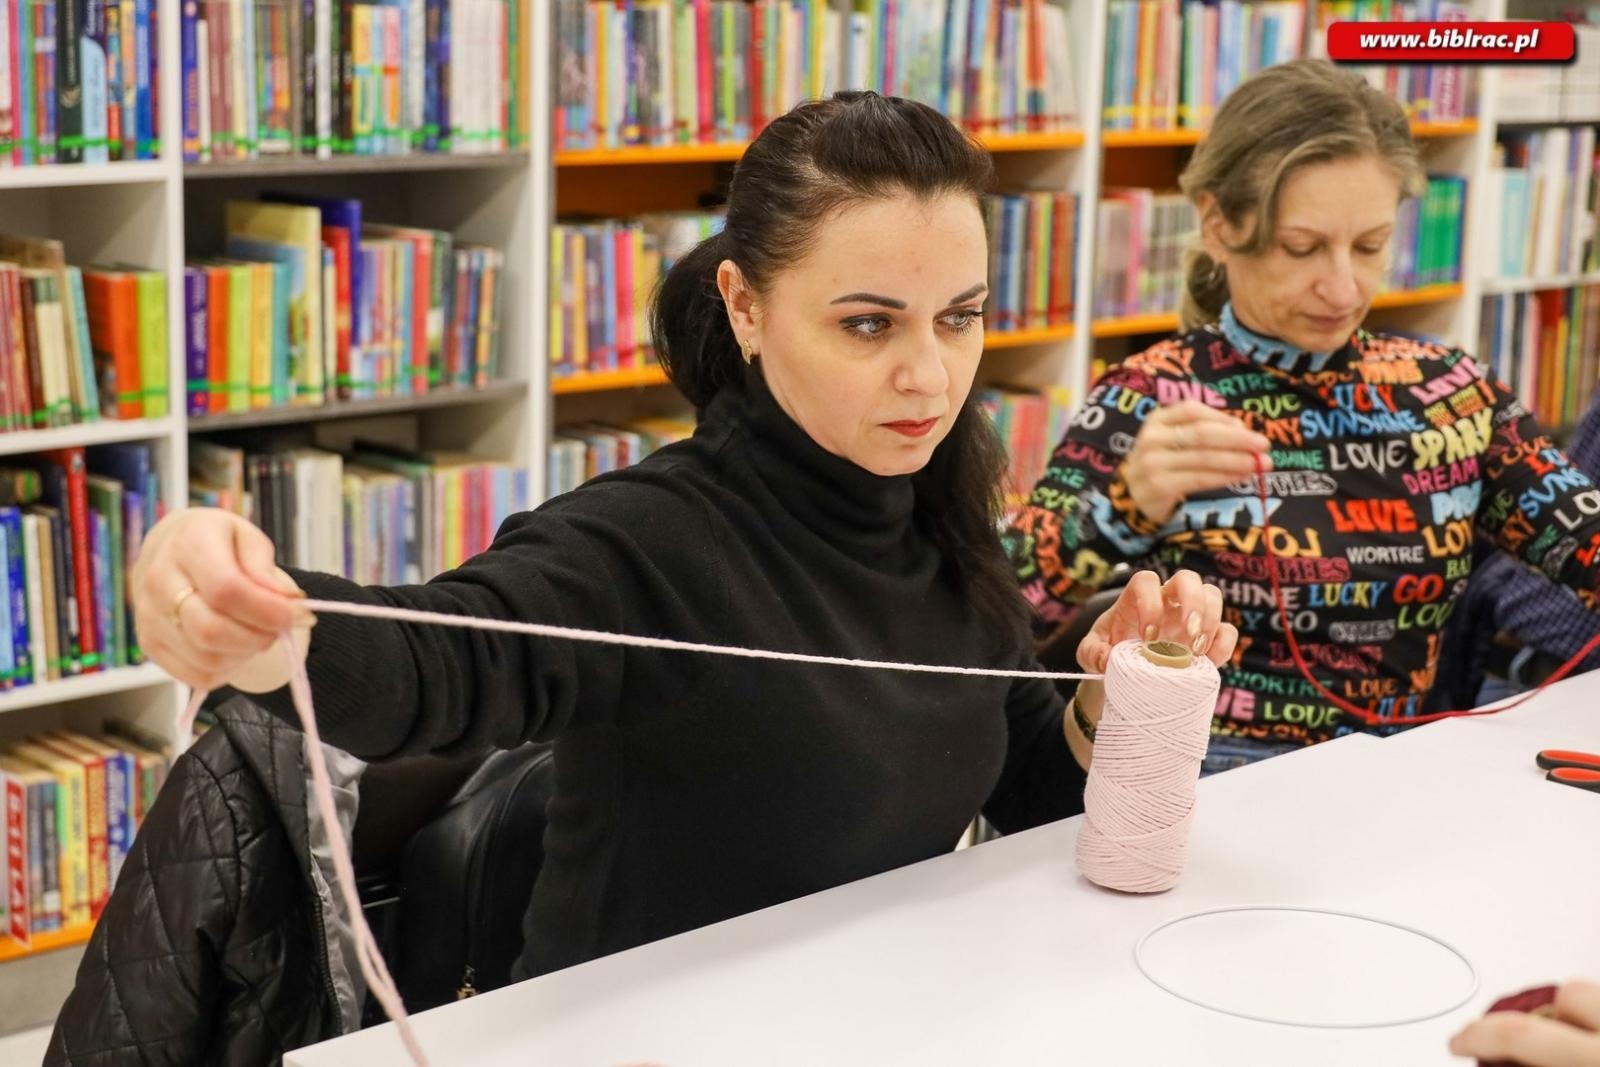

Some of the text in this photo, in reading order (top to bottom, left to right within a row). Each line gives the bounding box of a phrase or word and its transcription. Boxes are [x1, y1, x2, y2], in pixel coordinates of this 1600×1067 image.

[1327, 439, 1408, 478] LOVE
[1402, 456, 1480, 496] DREAM
[1325, 498, 1418, 534] LOVE
[1345, 544, 1425, 565] WORTRE
[1308, 580, 1388, 609] LUCKY
[1393, 573, 1445, 605] GO
[1269, 610, 1319, 633] GO
[1263, 701, 1345, 728] LOVE
